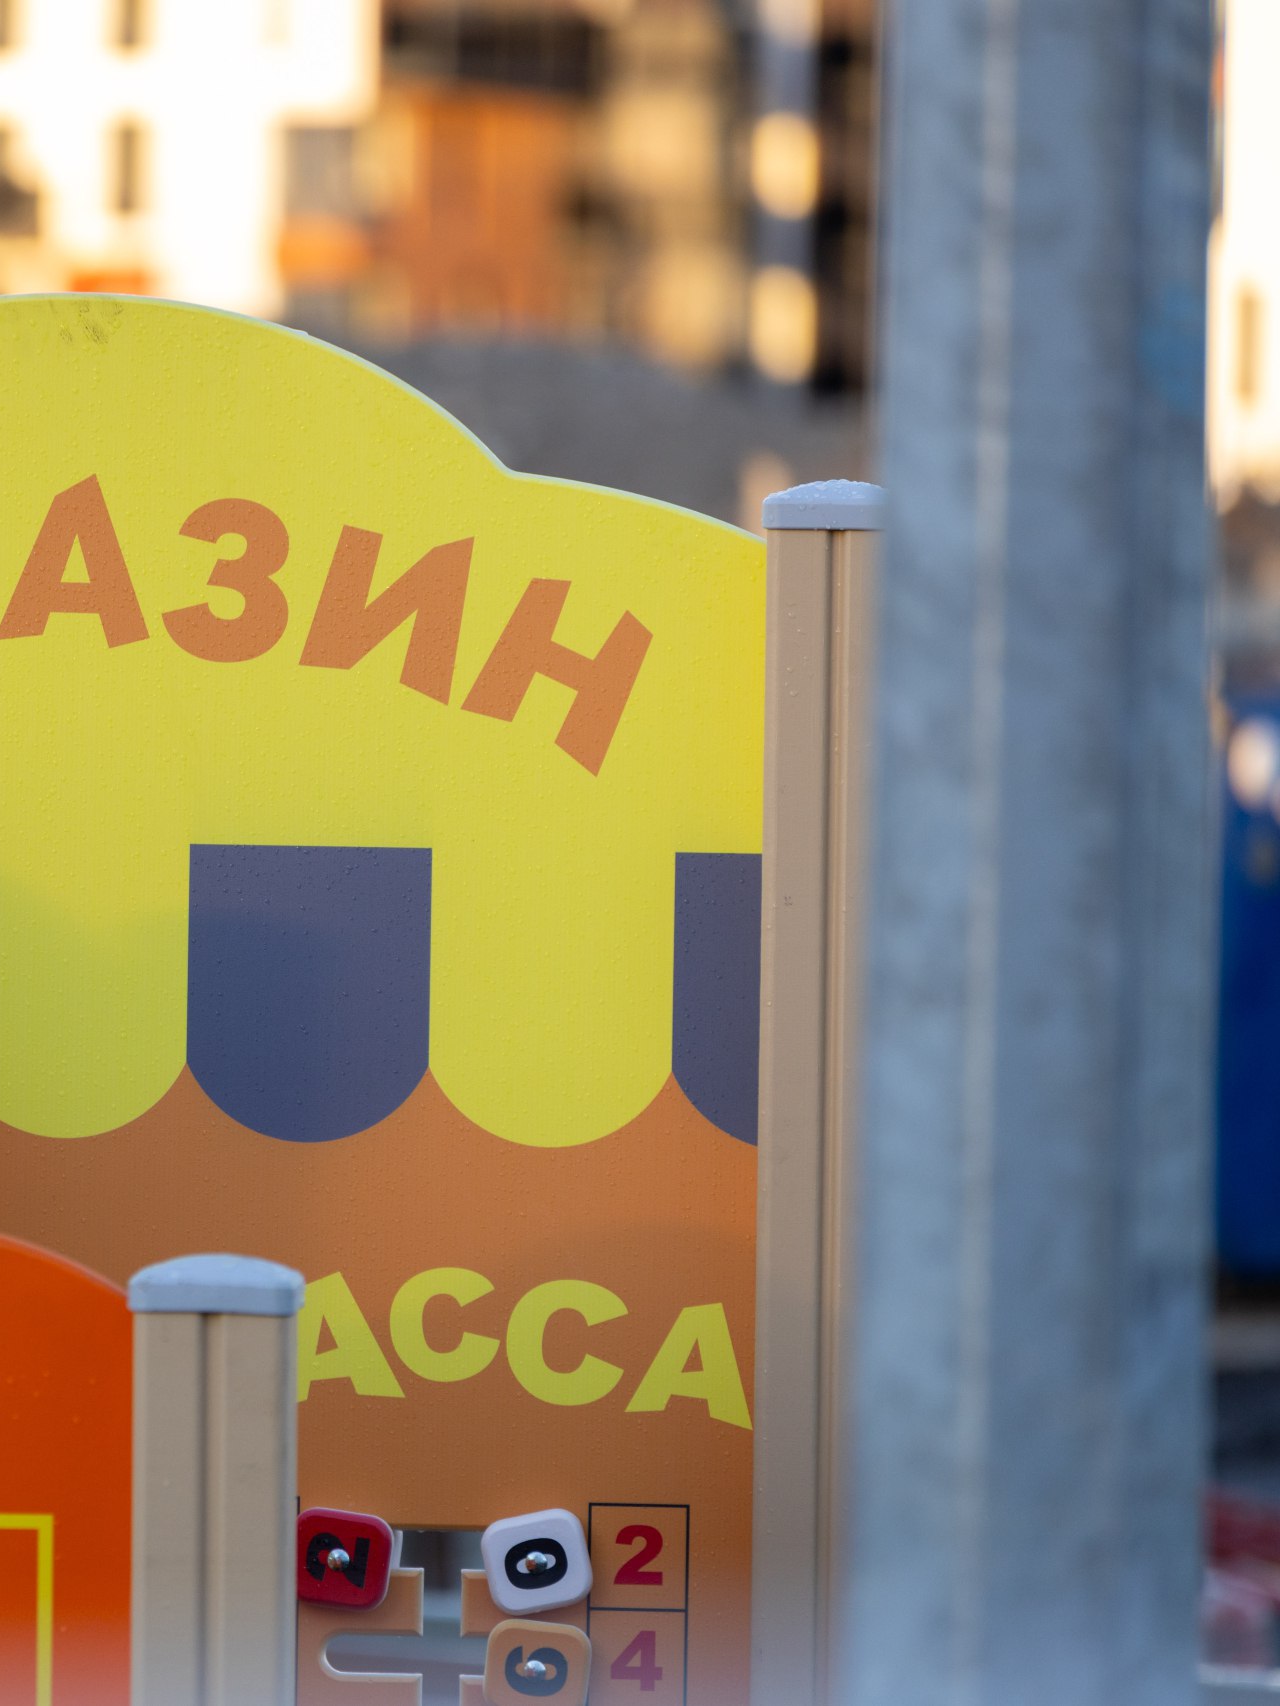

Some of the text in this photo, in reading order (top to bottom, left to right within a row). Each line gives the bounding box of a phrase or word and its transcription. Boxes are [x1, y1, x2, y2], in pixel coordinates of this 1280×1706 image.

[297, 1267, 754, 1431] АССА
[305, 1532, 371, 1589] 2
[613, 1524, 664, 1586] 2
[610, 1630, 663, 1691] 4
